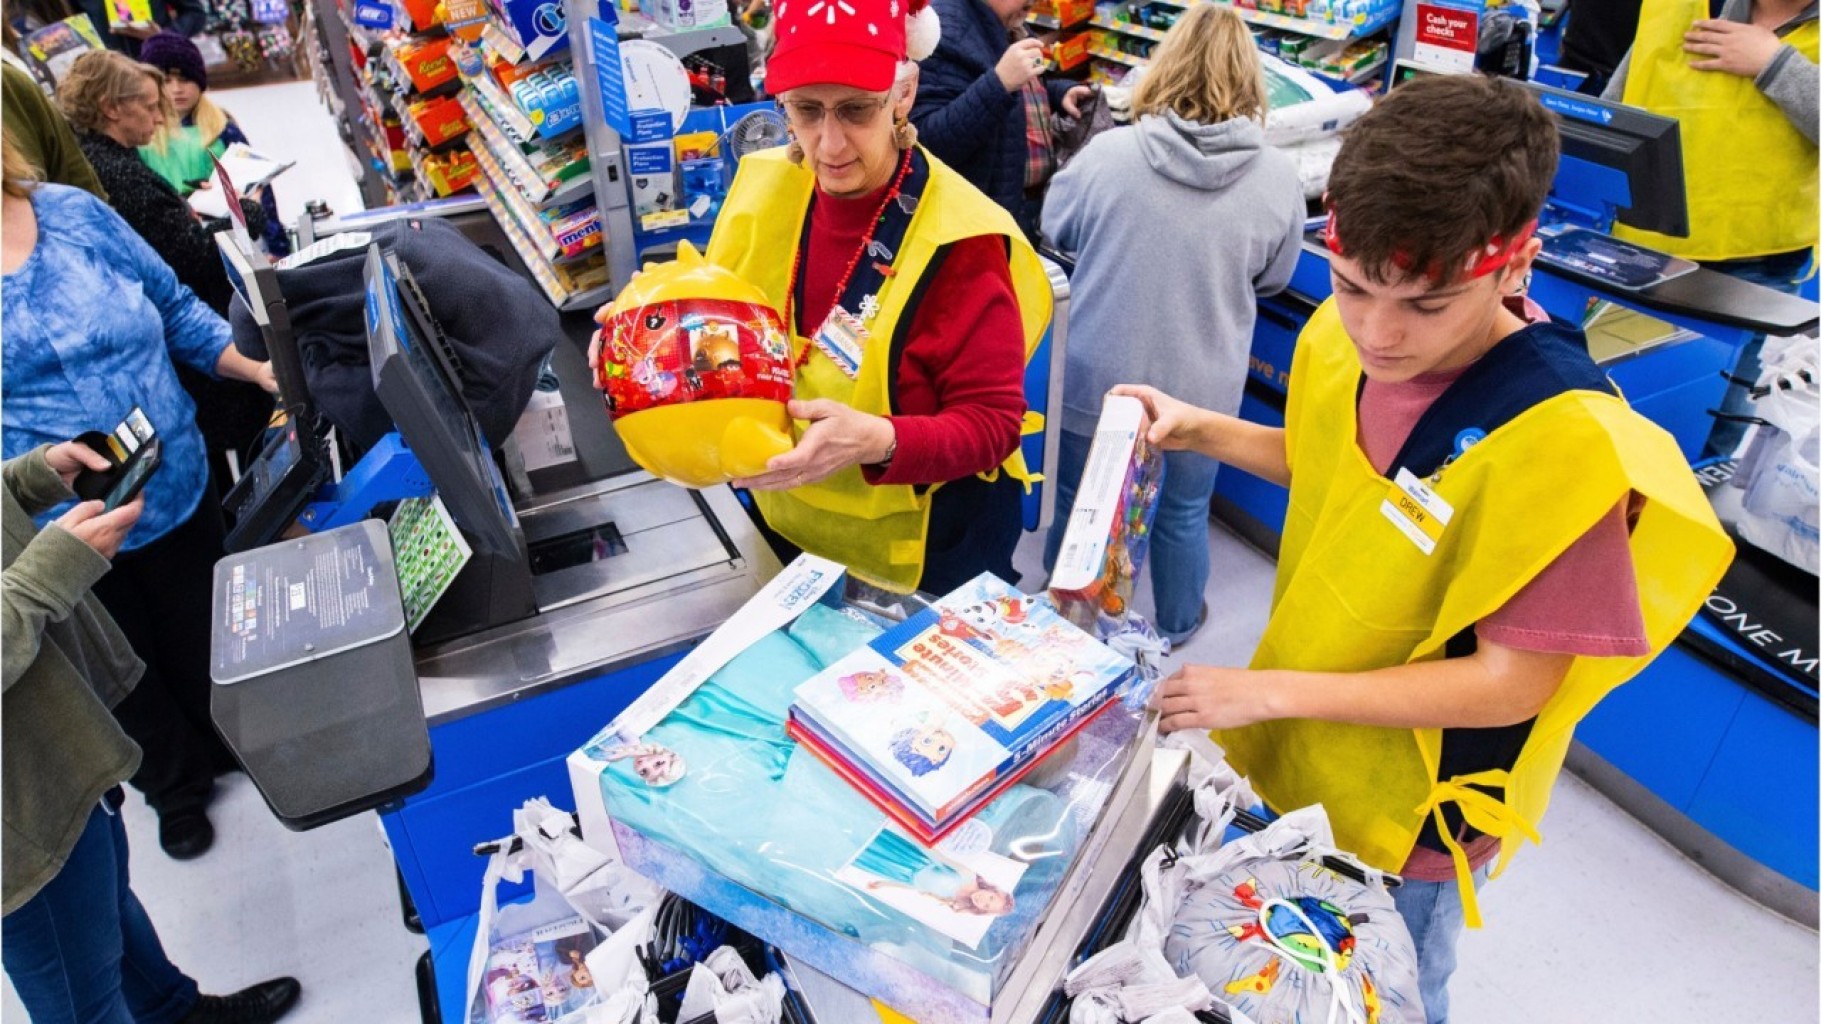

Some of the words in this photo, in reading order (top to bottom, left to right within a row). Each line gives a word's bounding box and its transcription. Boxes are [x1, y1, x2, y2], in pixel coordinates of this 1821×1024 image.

[1426, 12, 1448, 25] Cash
[1448, 18, 1468, 29] your
[1426, 24, 1455, 37] checks
[561, 219, 603, 247] ment
[1399, 496, 1426, 523] DREW
[1704, 586, 1783, 648] ONE
[1777, 647, 1821, 673] M
[1012, 717, 1068, 763] 5-Minute
[1069, 687, 1108, 721] Stories
